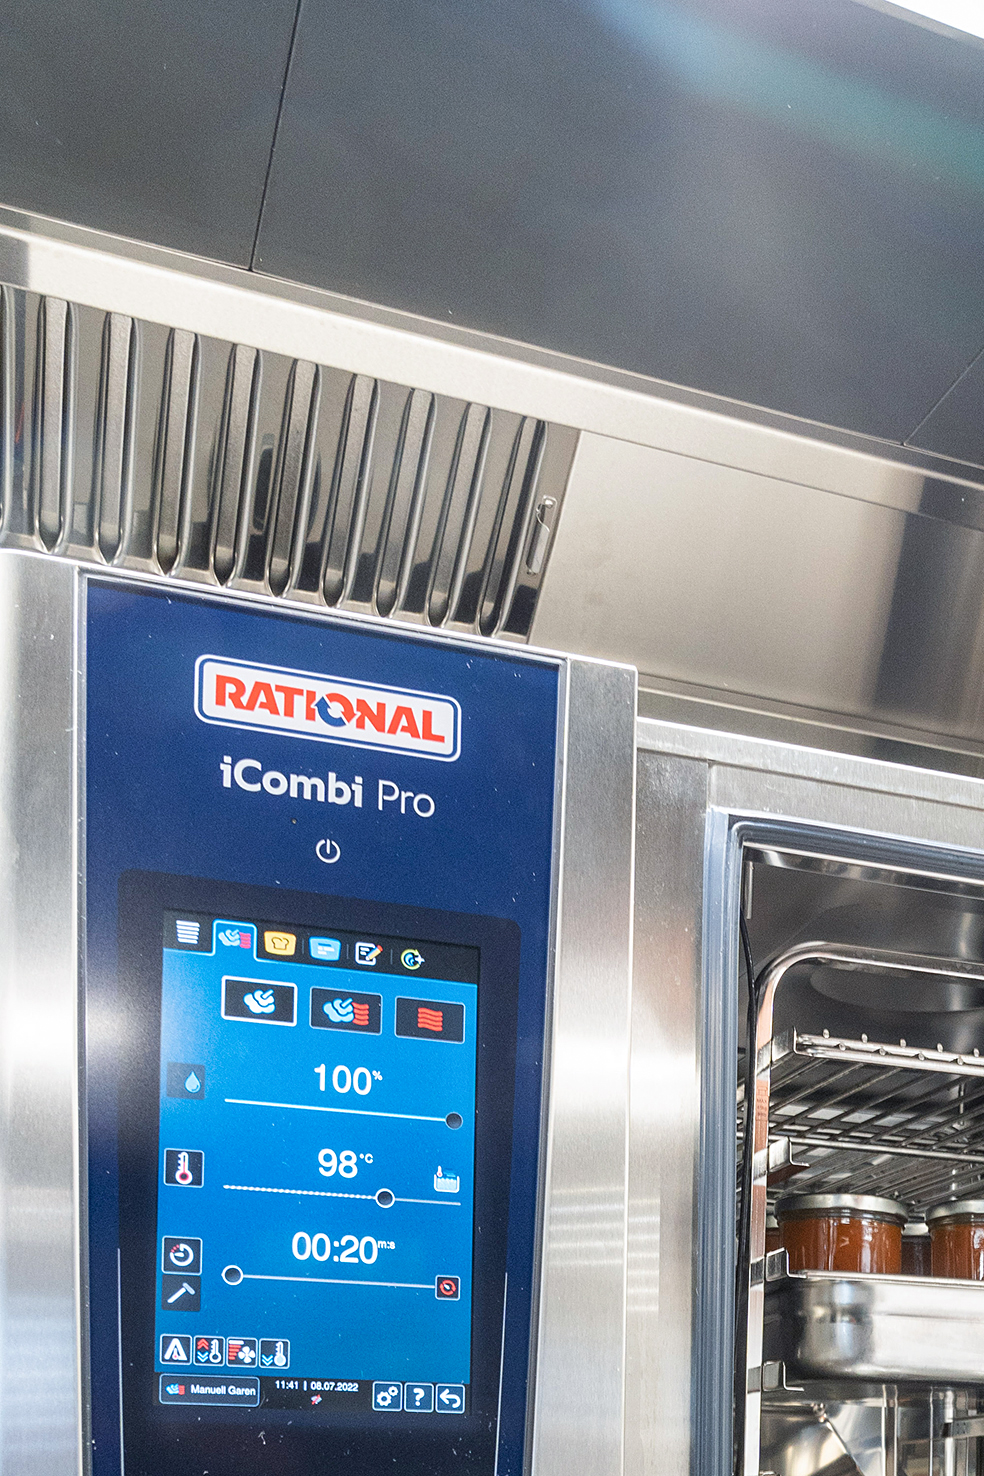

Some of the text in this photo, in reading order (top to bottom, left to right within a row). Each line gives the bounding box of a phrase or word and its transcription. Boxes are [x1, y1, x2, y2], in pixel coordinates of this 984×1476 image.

[214, 674, 446, 744] RATIONAL
[219, 755, 436, 818] iCombi Pro
[190, 1384, 257, 1397] Manuell Garen
[274, 1380, 359, 1393] 11:41 08.07.2022
